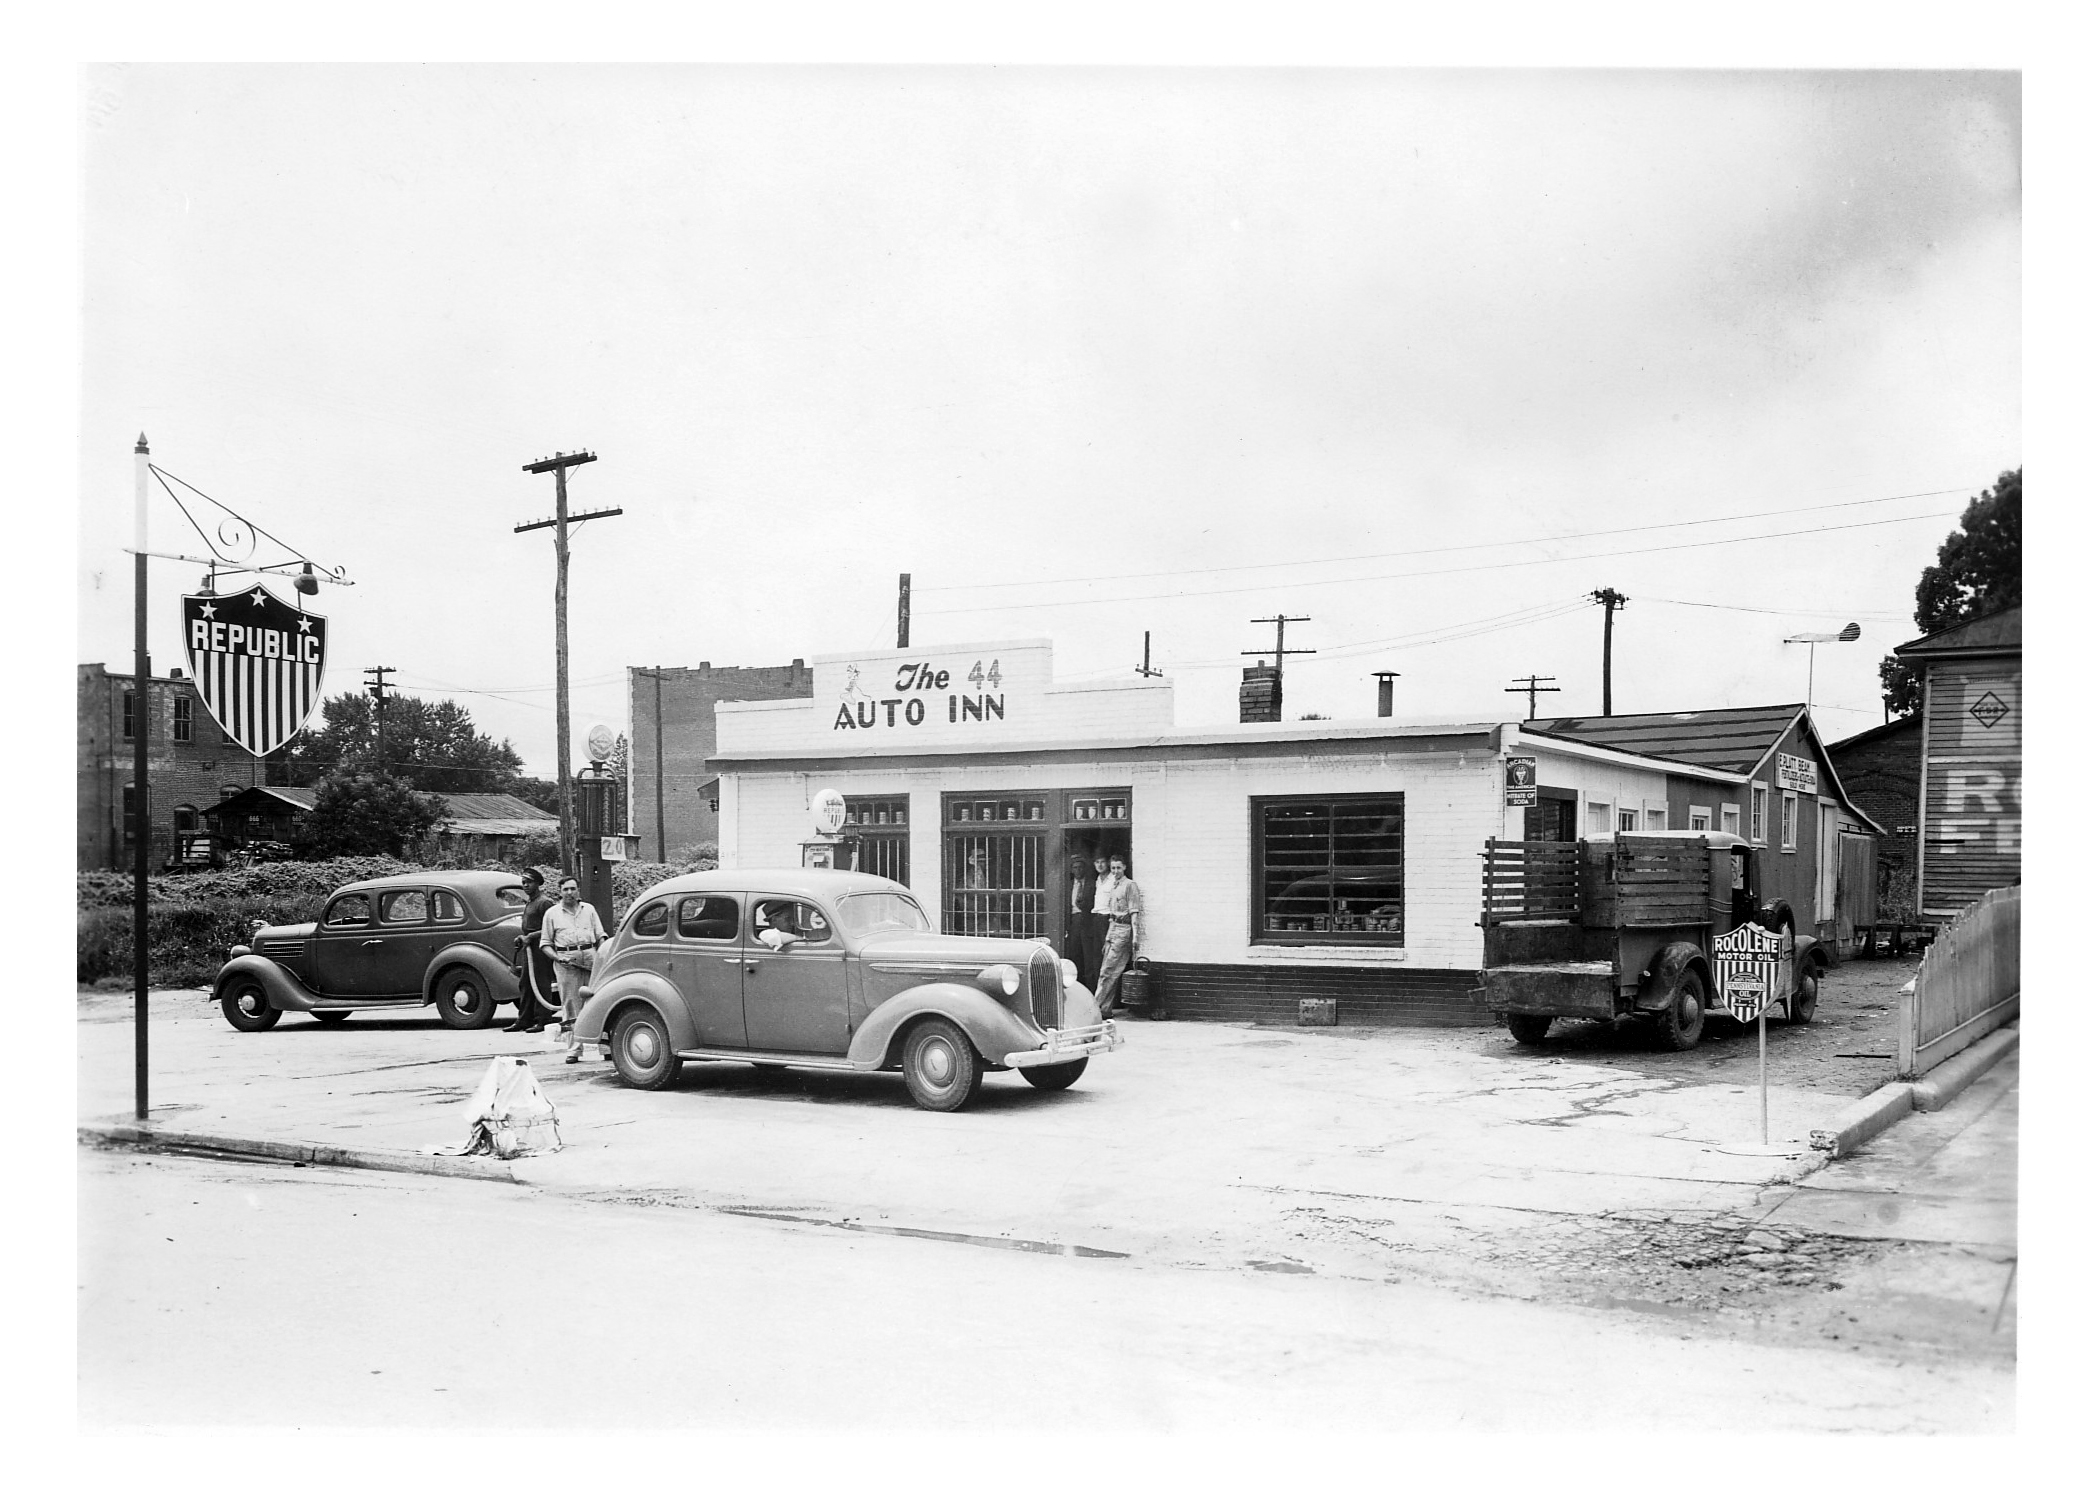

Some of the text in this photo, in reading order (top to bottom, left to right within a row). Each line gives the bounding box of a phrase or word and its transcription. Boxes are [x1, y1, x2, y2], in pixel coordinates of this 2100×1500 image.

[192, 619, 319, 664] REPUBLIC
[895, 658, 1003, 692] The 44
[833, 693, 1004, 730] AUTO INN
[1506, 758, 1535, 769] ARCADIAN
[1947, 769, 2022, 812] R
[1714, 928, 1779, 953] ROCOLENE
[1717, 952, 1775, 962] MOTOR OIL
[1726, 982, 1764, 990] PENNSYLVANIA
